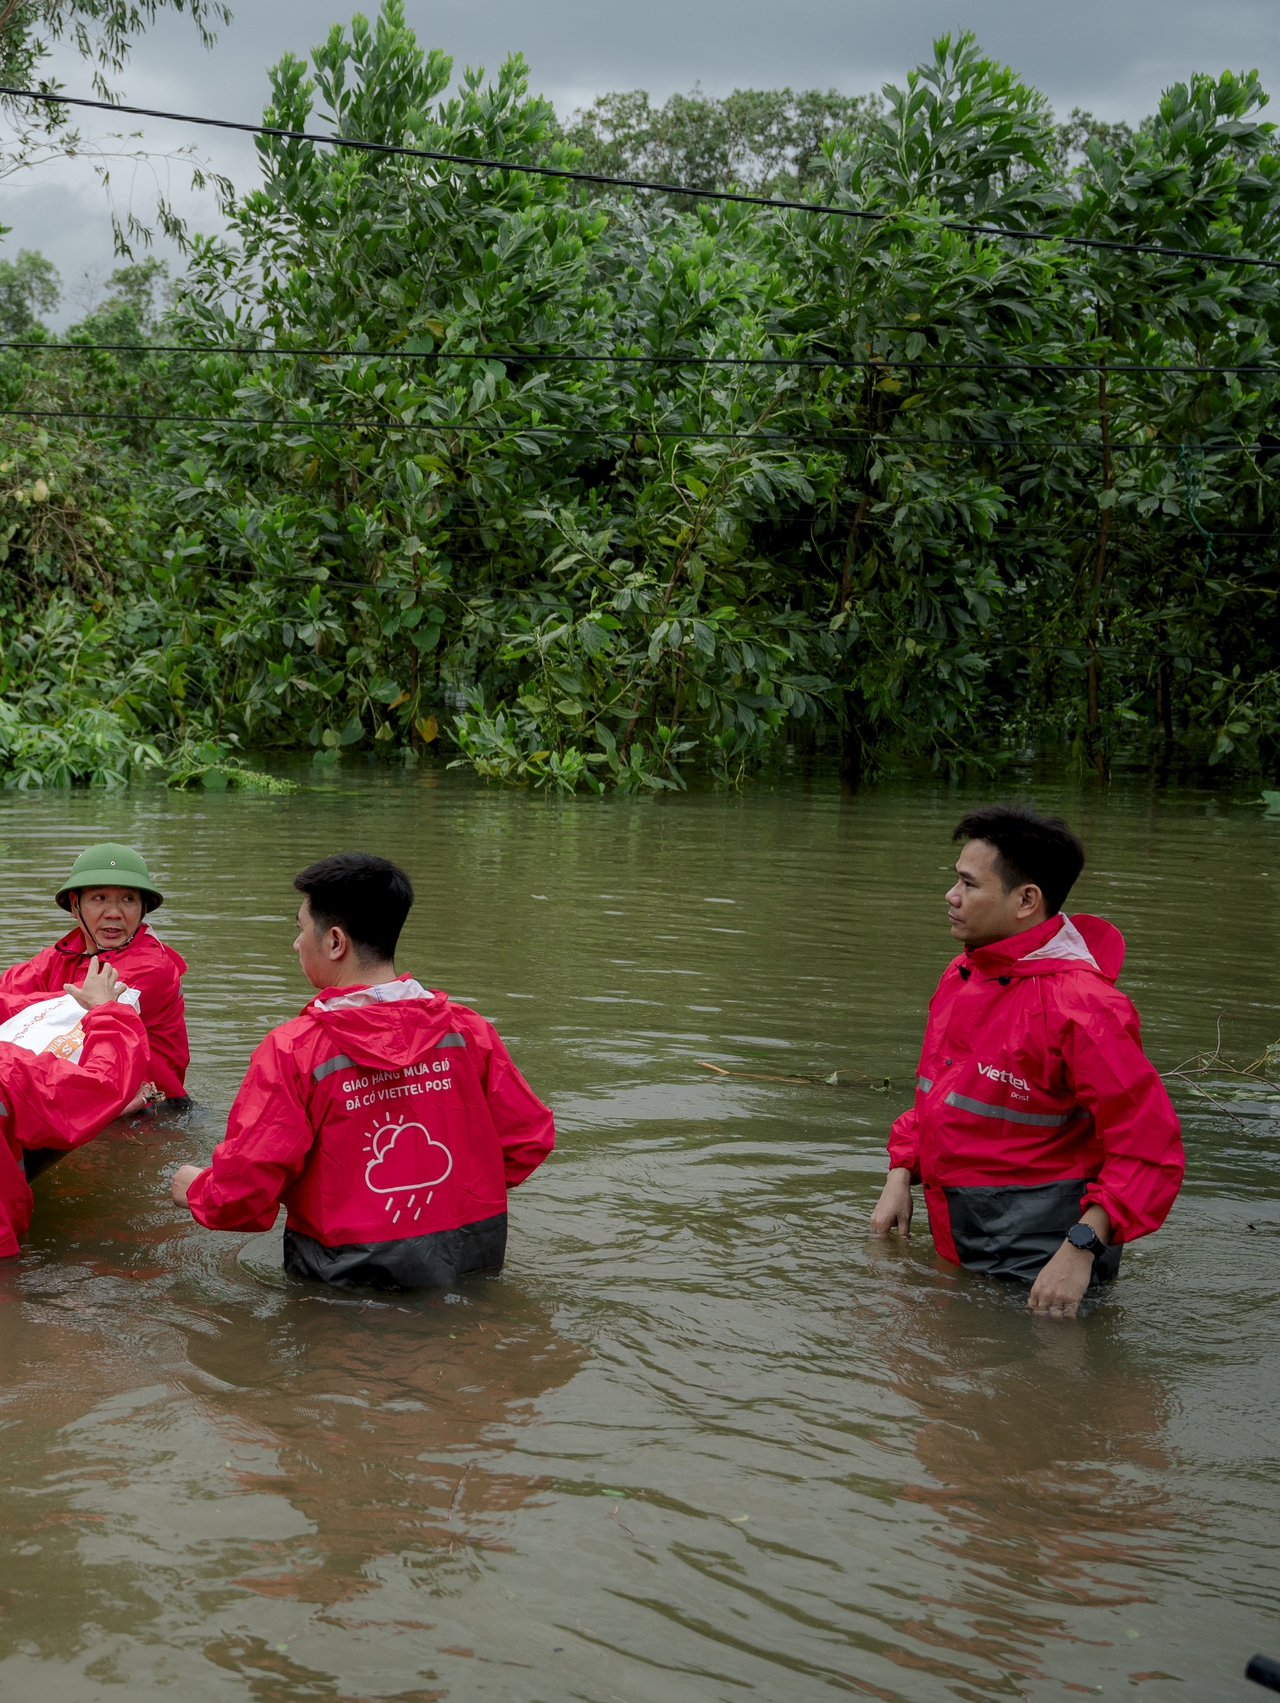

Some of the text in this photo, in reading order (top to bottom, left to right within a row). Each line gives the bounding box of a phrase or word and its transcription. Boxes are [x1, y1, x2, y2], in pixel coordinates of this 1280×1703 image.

[342, 1057, 450, 1093] GIAO HÀNG MƯA GIÓ
[977, 1061, 1031, 1091] viettel
[345, 1078, 452, 1111] ĐÃ CÓ VIETTEL POST
[1010, 1091, 1030, 1102] post
